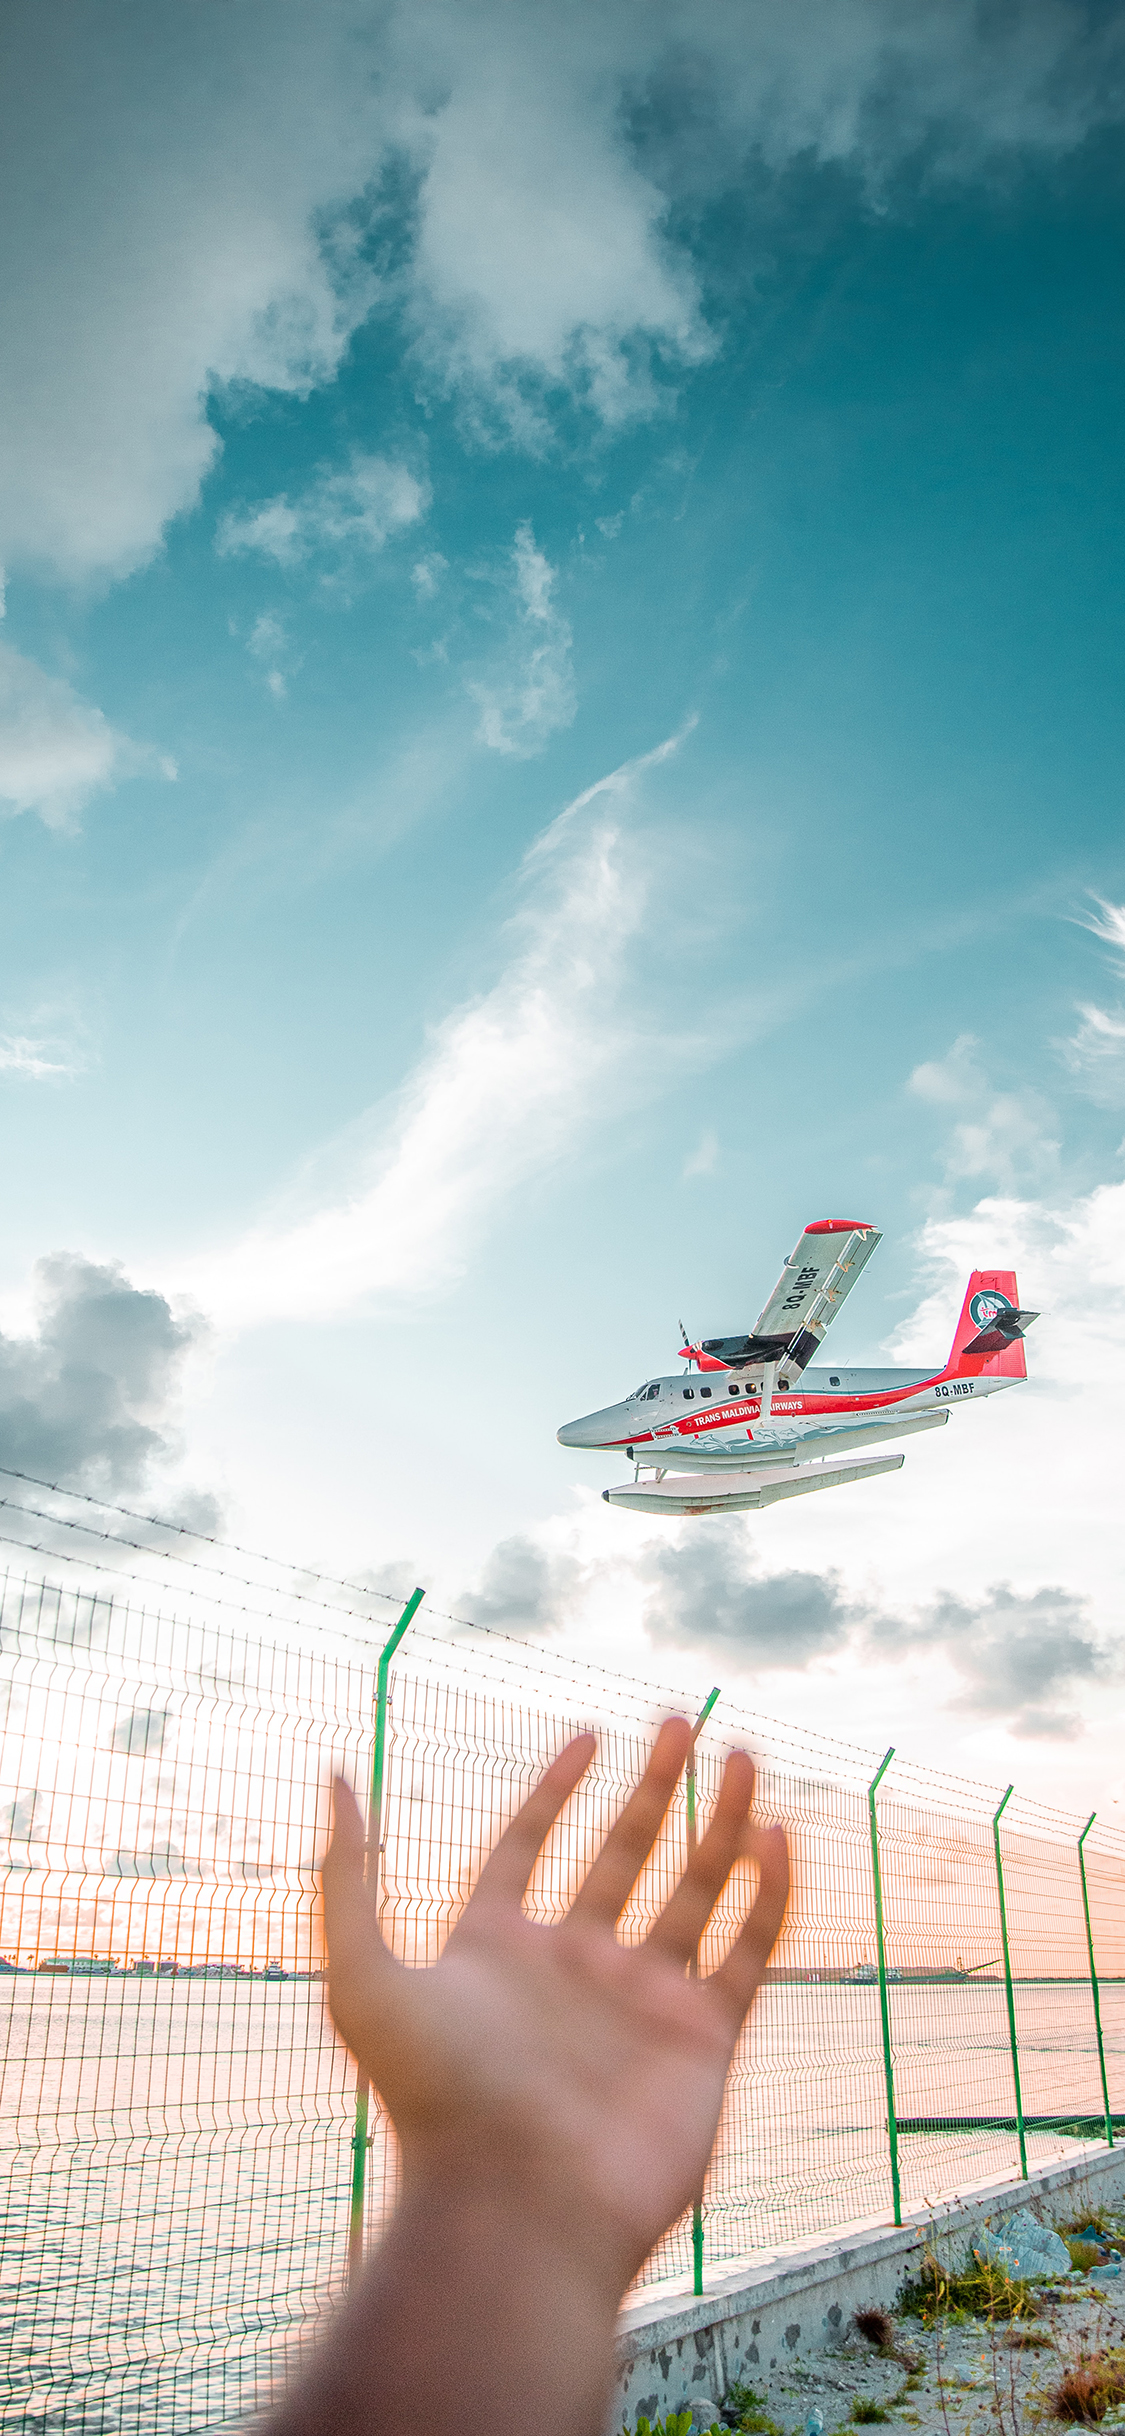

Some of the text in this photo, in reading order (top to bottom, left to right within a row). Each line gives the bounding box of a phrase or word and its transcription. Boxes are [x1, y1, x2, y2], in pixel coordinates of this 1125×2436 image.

[781, 1267, 820, 1310] 8Q-MBF
[934, 1382, 975, 1398] 8Q-MBF
[694, 1412, 721, 1427] TRANS
[721, 1405, 762, 1420] MALDIVIA
